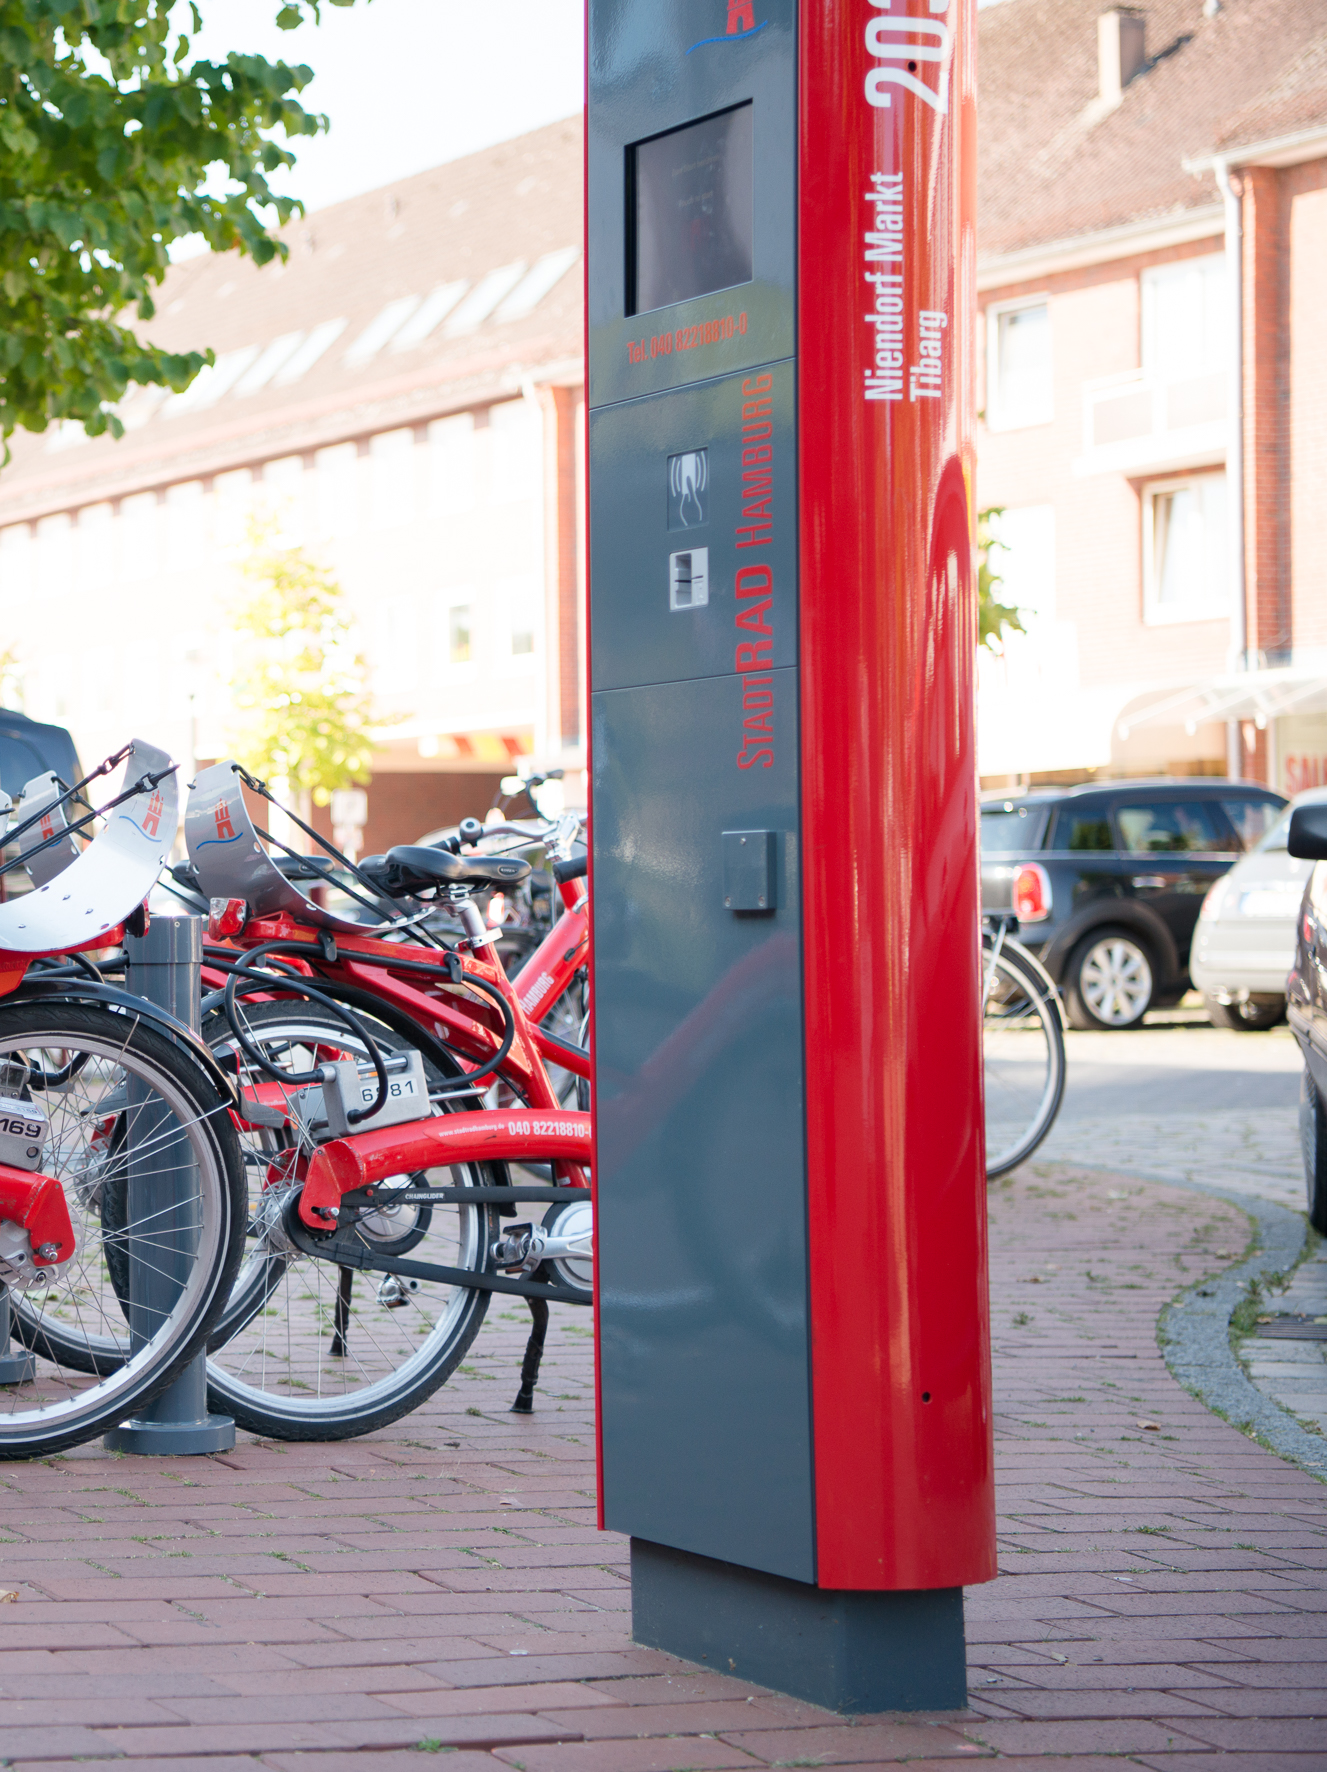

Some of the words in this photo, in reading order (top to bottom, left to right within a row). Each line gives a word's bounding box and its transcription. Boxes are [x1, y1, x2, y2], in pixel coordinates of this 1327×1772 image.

[864, 0, 949, 114] 20
[865, 171, 903, 262] Markt
[627, 339, 649, 364] Tel.
[650, 332, 673, 359] 040
[675, 312, 748, 352] 82218810-0
[865, 273, 903, 400] Niendorf
[910, 310, 948, 402] Tibarg
[508, 1121, 530, 1136] 040
[533, 1121, 592, 1139] 82218810-
